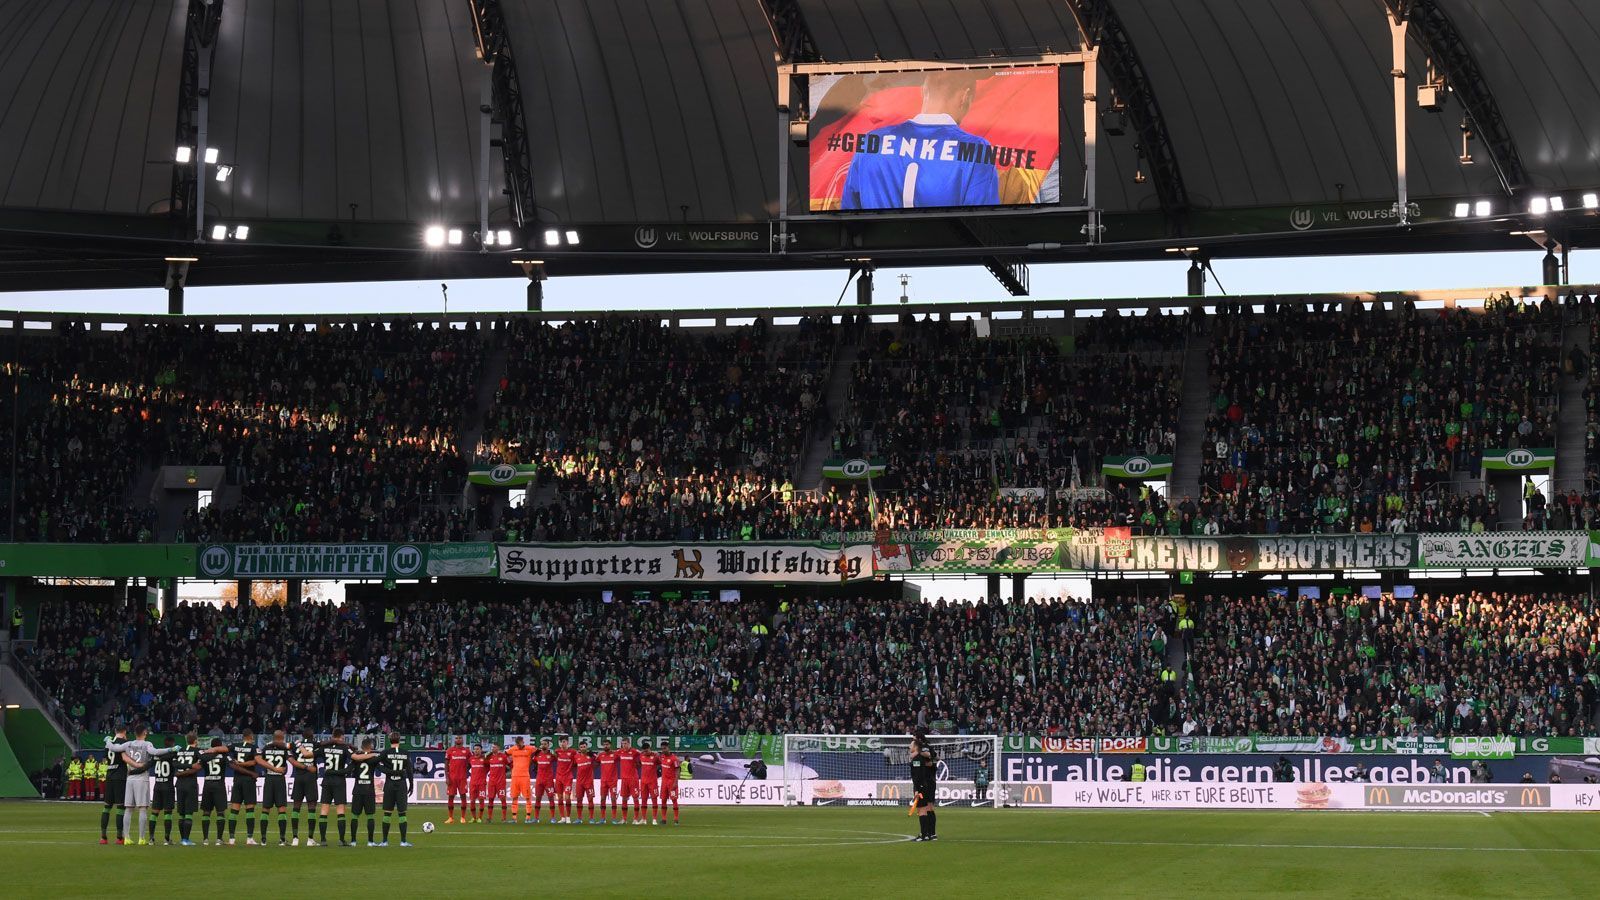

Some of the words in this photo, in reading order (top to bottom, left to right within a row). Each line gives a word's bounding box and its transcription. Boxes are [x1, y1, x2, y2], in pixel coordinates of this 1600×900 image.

[827, 133, 1037, 170] #GEDENKEMINUTE
[666, 232, 683, 241] VfL
[689, 231, 759, 241] WOLFSBURG
[346, 546, 385, 554] UNSER
[1258, 538, 1411, 570] BROTHERS
[1457, 539, 1566, 559] ANGELS
[236, 554, 385, 572] ZINNENWAPPEN
[504, 549, 662, 581] Supporters
[1451, 736, 1514, 756] CROYA
[154, 761, 171, 778] 40
[207, 758, 221, 776] 15
[325, 754, 340, 771] 31
[359, 762, 369, 779] 2
[391, 759, 403, 771] 11
[1007, 757, 1058, 782] Für
[1067, 757, 1124, 782] alle
[1145, 757, 1191, 782] die
[1200, 765, 1273, 783] gern
[718, 784, 746, 799] EURE
[1075, 790, 1093, 803] HEY
[1097, 786, 1145, 804] WÖLFE,
[1196, 787, 1226, 803] EURE
[1230, 787, 1278, 803] BEUTE.
[1404, 789, 1506, 804] McDonald's
[1575, 793, 1593, 806] HEY
